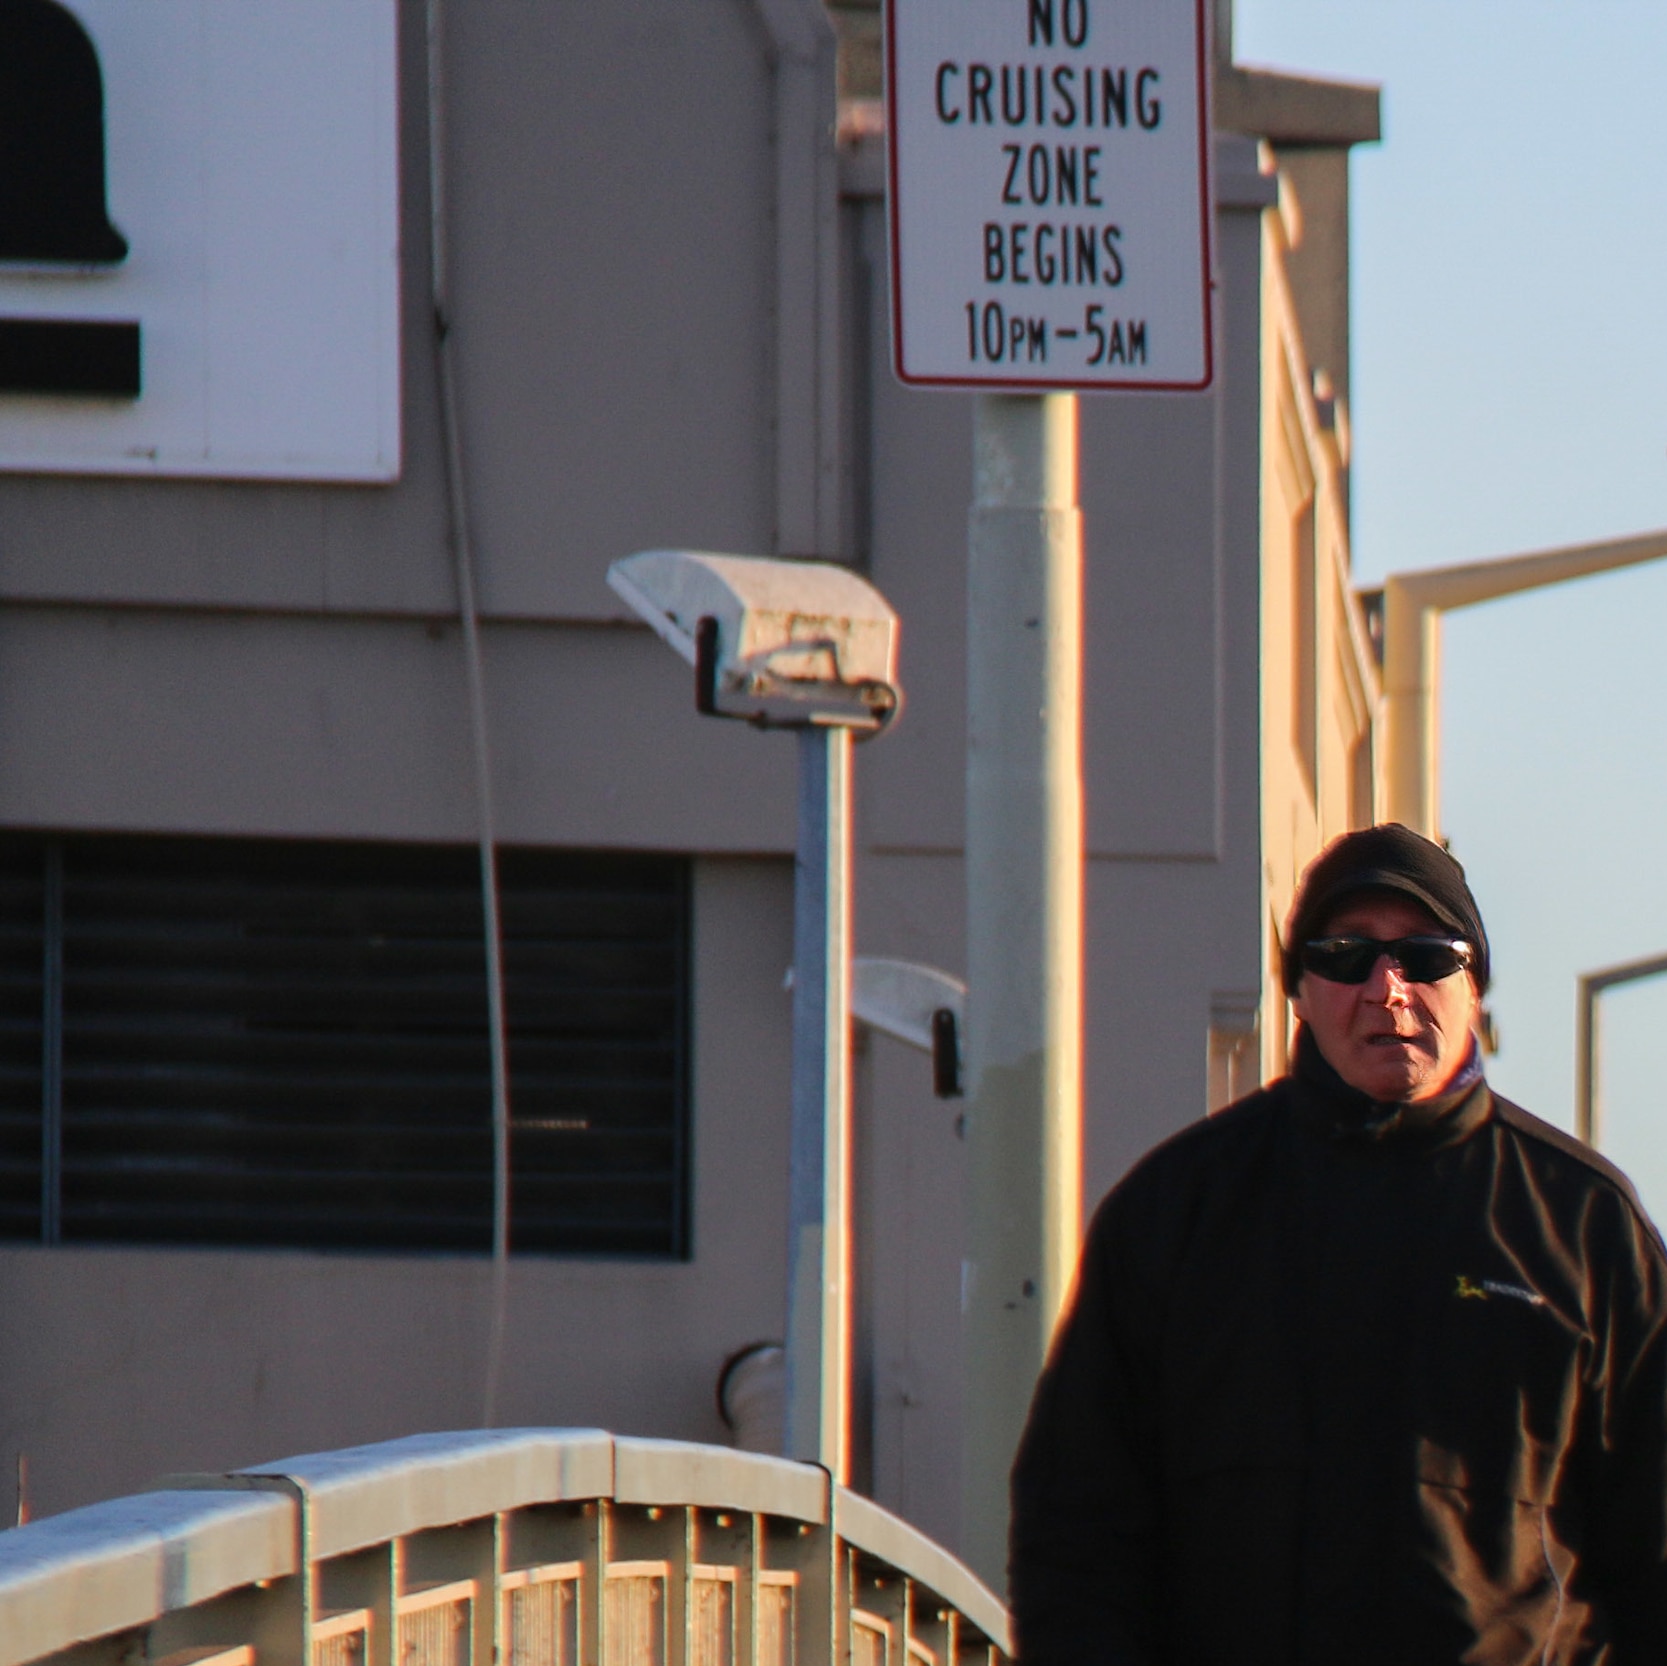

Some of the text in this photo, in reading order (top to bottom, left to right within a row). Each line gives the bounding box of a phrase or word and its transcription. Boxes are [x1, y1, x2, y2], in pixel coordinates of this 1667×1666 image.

[1028, 0, 1088, 49] NO
[936, 61, 1161, 130] CRUISING
[1003, 143, 1102, 207] ZONE
[984, 223, 1123, 287] BEGINS
